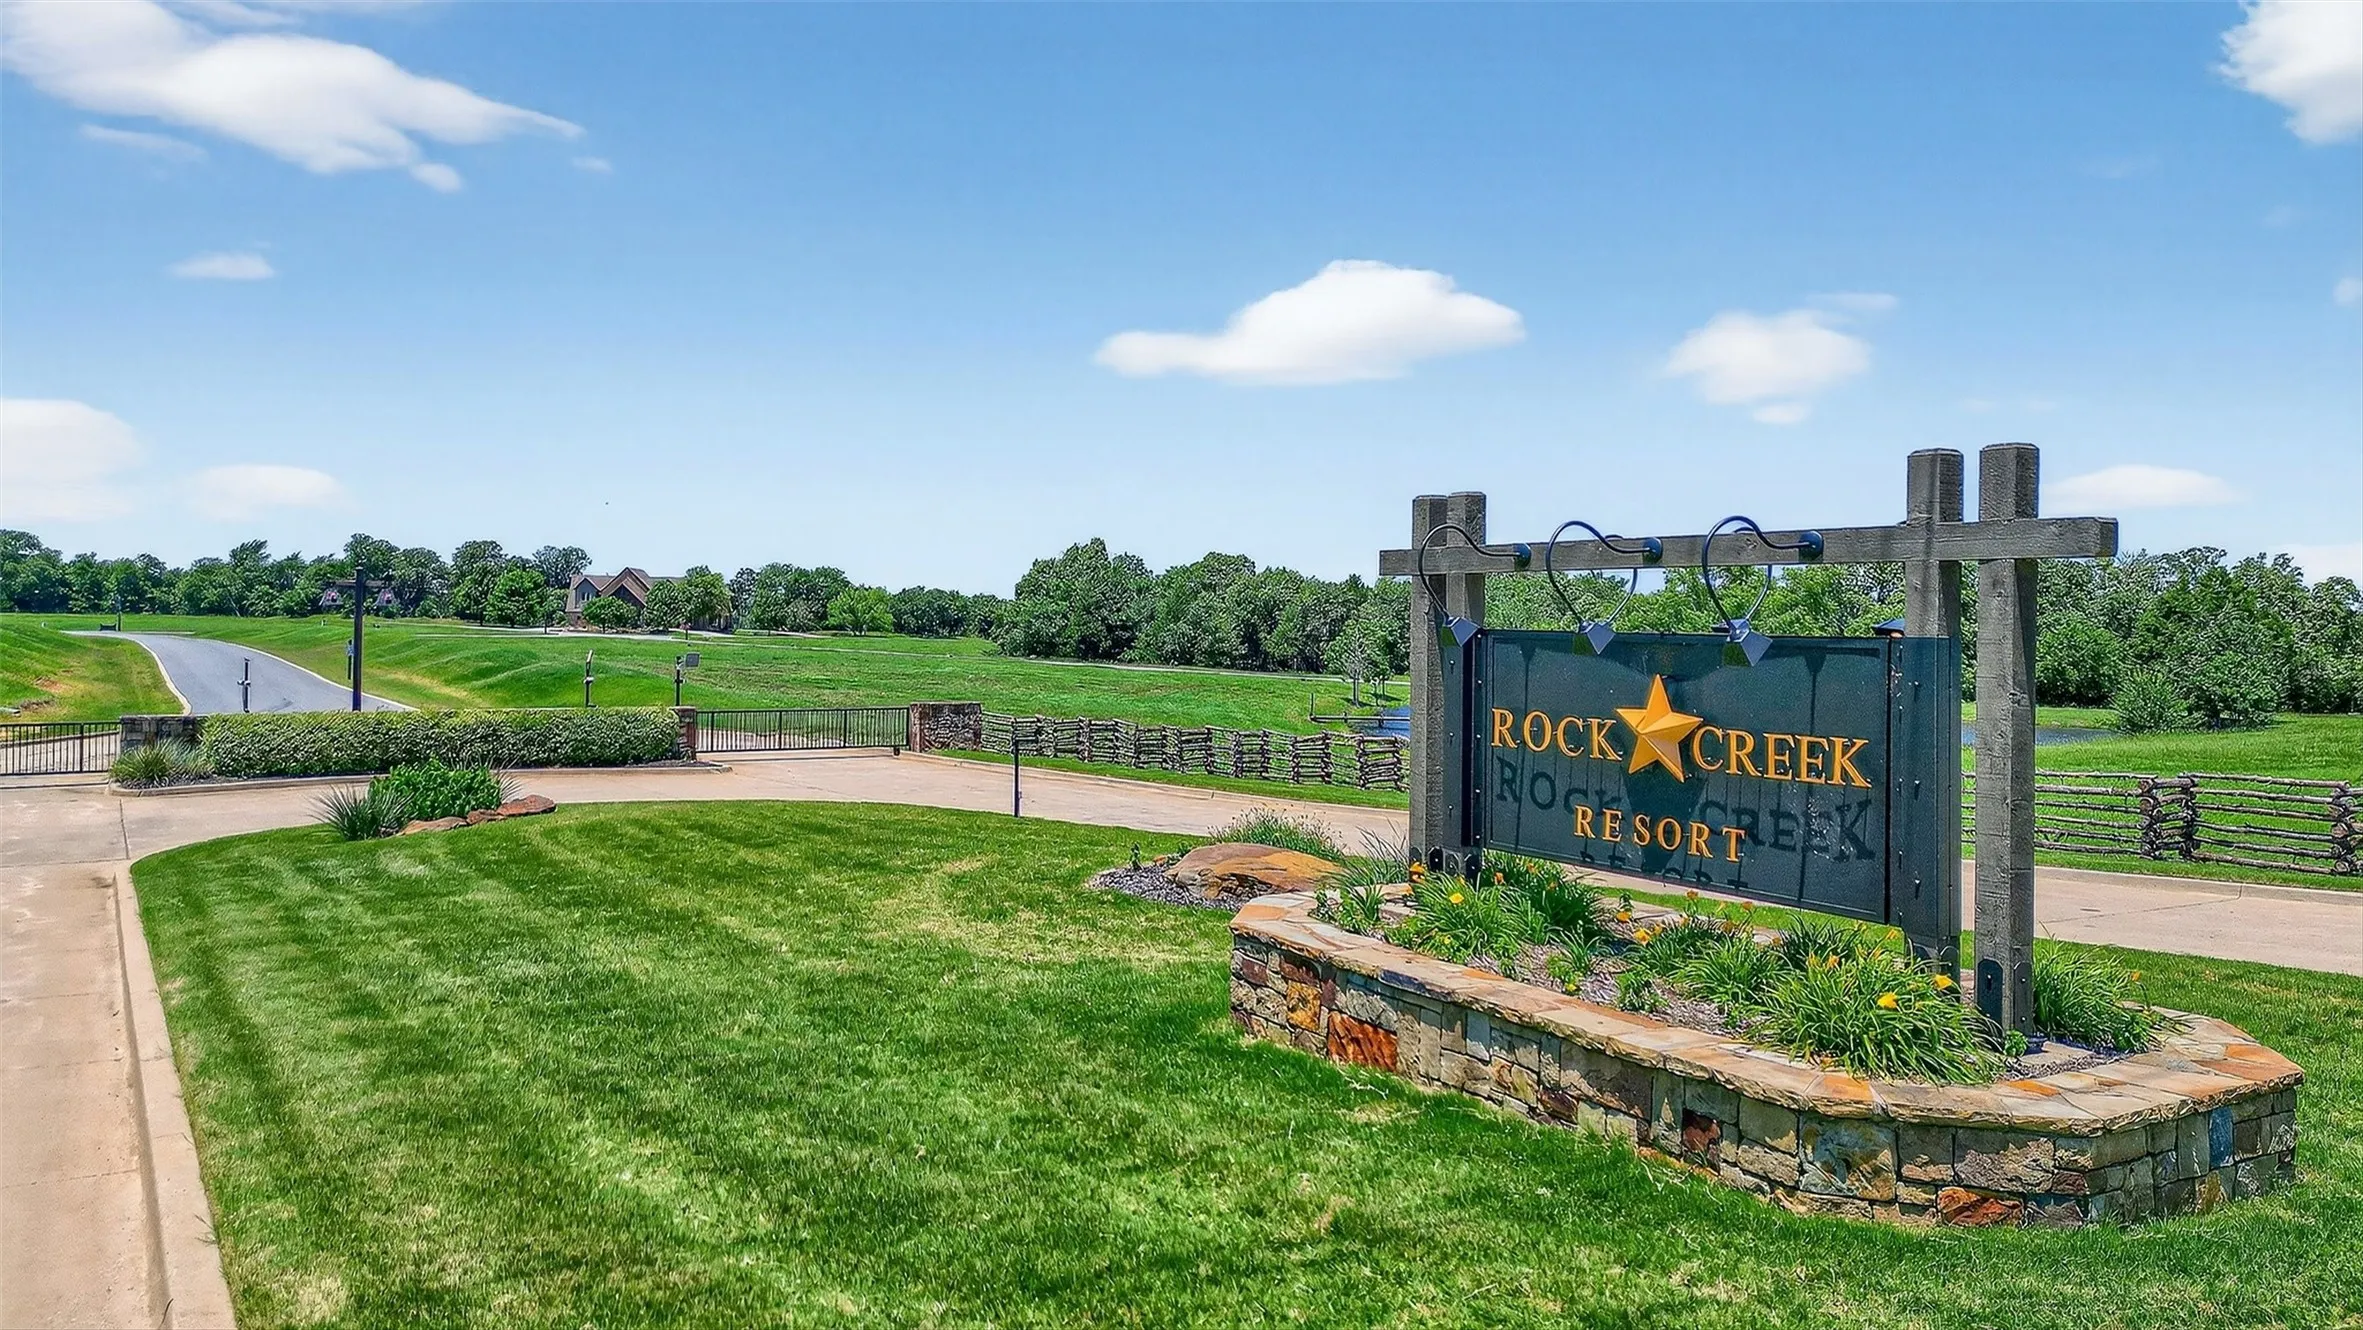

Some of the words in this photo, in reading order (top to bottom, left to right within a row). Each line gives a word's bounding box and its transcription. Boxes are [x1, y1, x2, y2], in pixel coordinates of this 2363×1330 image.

[1491, 707, 1622, 761] ROCK
[1691, 725, 1871, 788] CREEK
[1573, 804, 1746, 862] RESORT
